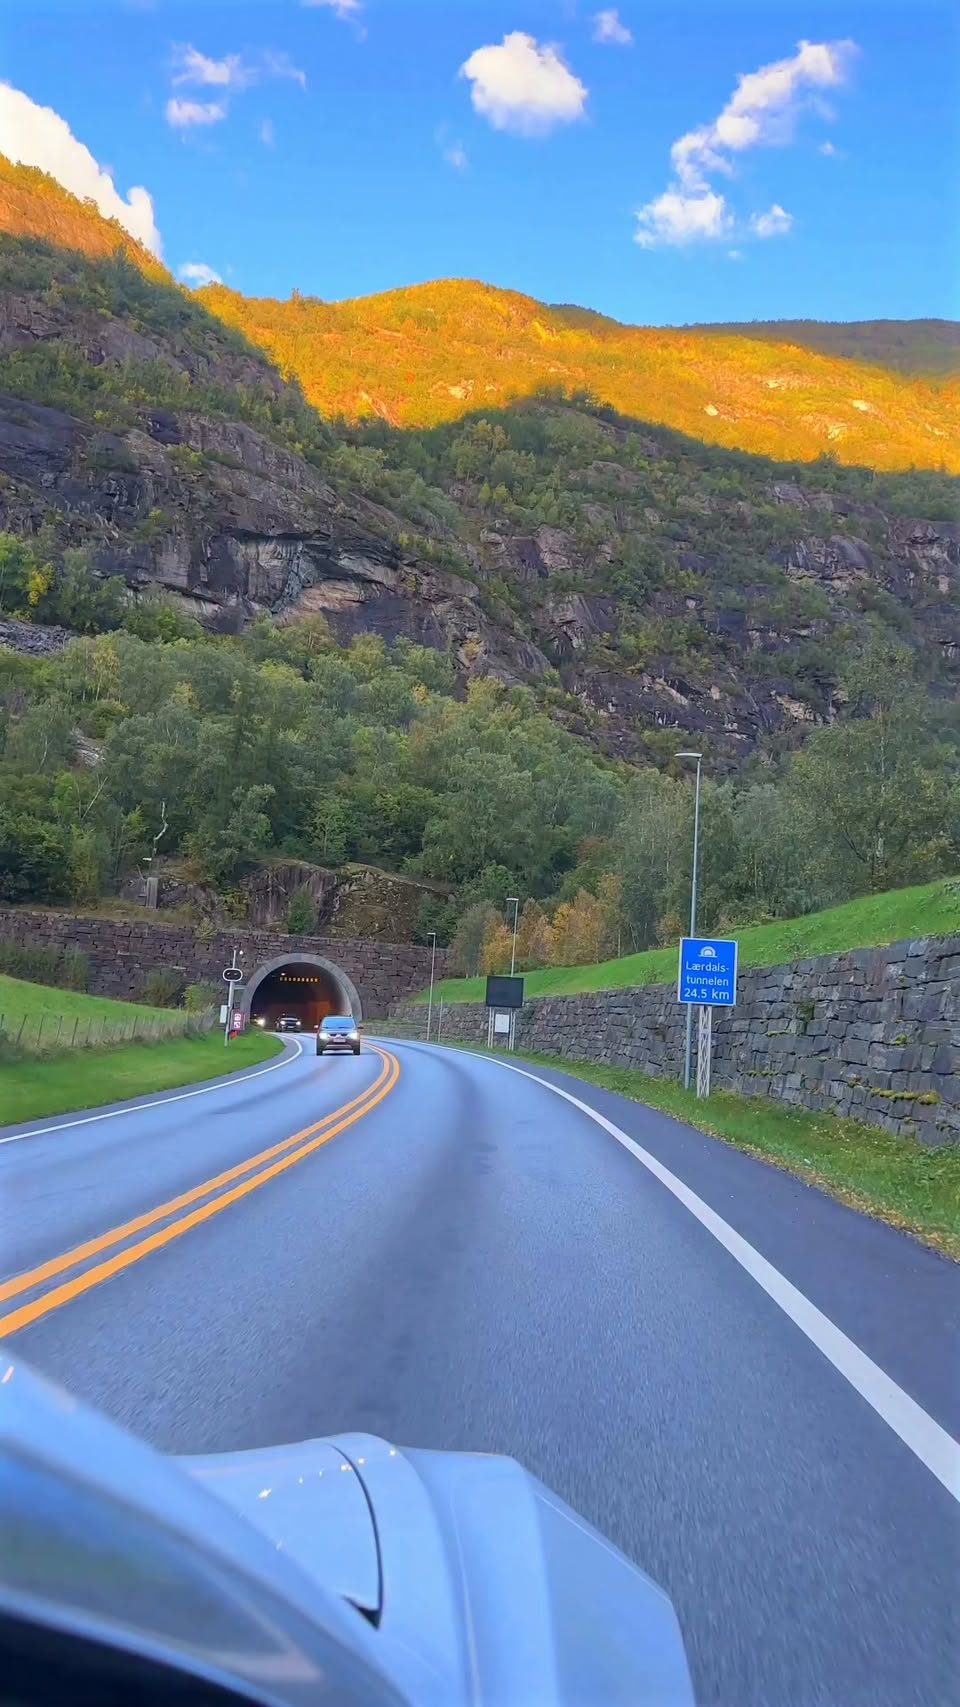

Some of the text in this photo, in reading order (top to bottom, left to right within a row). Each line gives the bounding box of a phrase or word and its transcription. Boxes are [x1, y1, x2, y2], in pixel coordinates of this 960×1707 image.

[686, 961, 729, 972] Lærdals-
[686, 975, 729, 986] tunnelen
[684, 988, 730, 1000] 24.5 km
